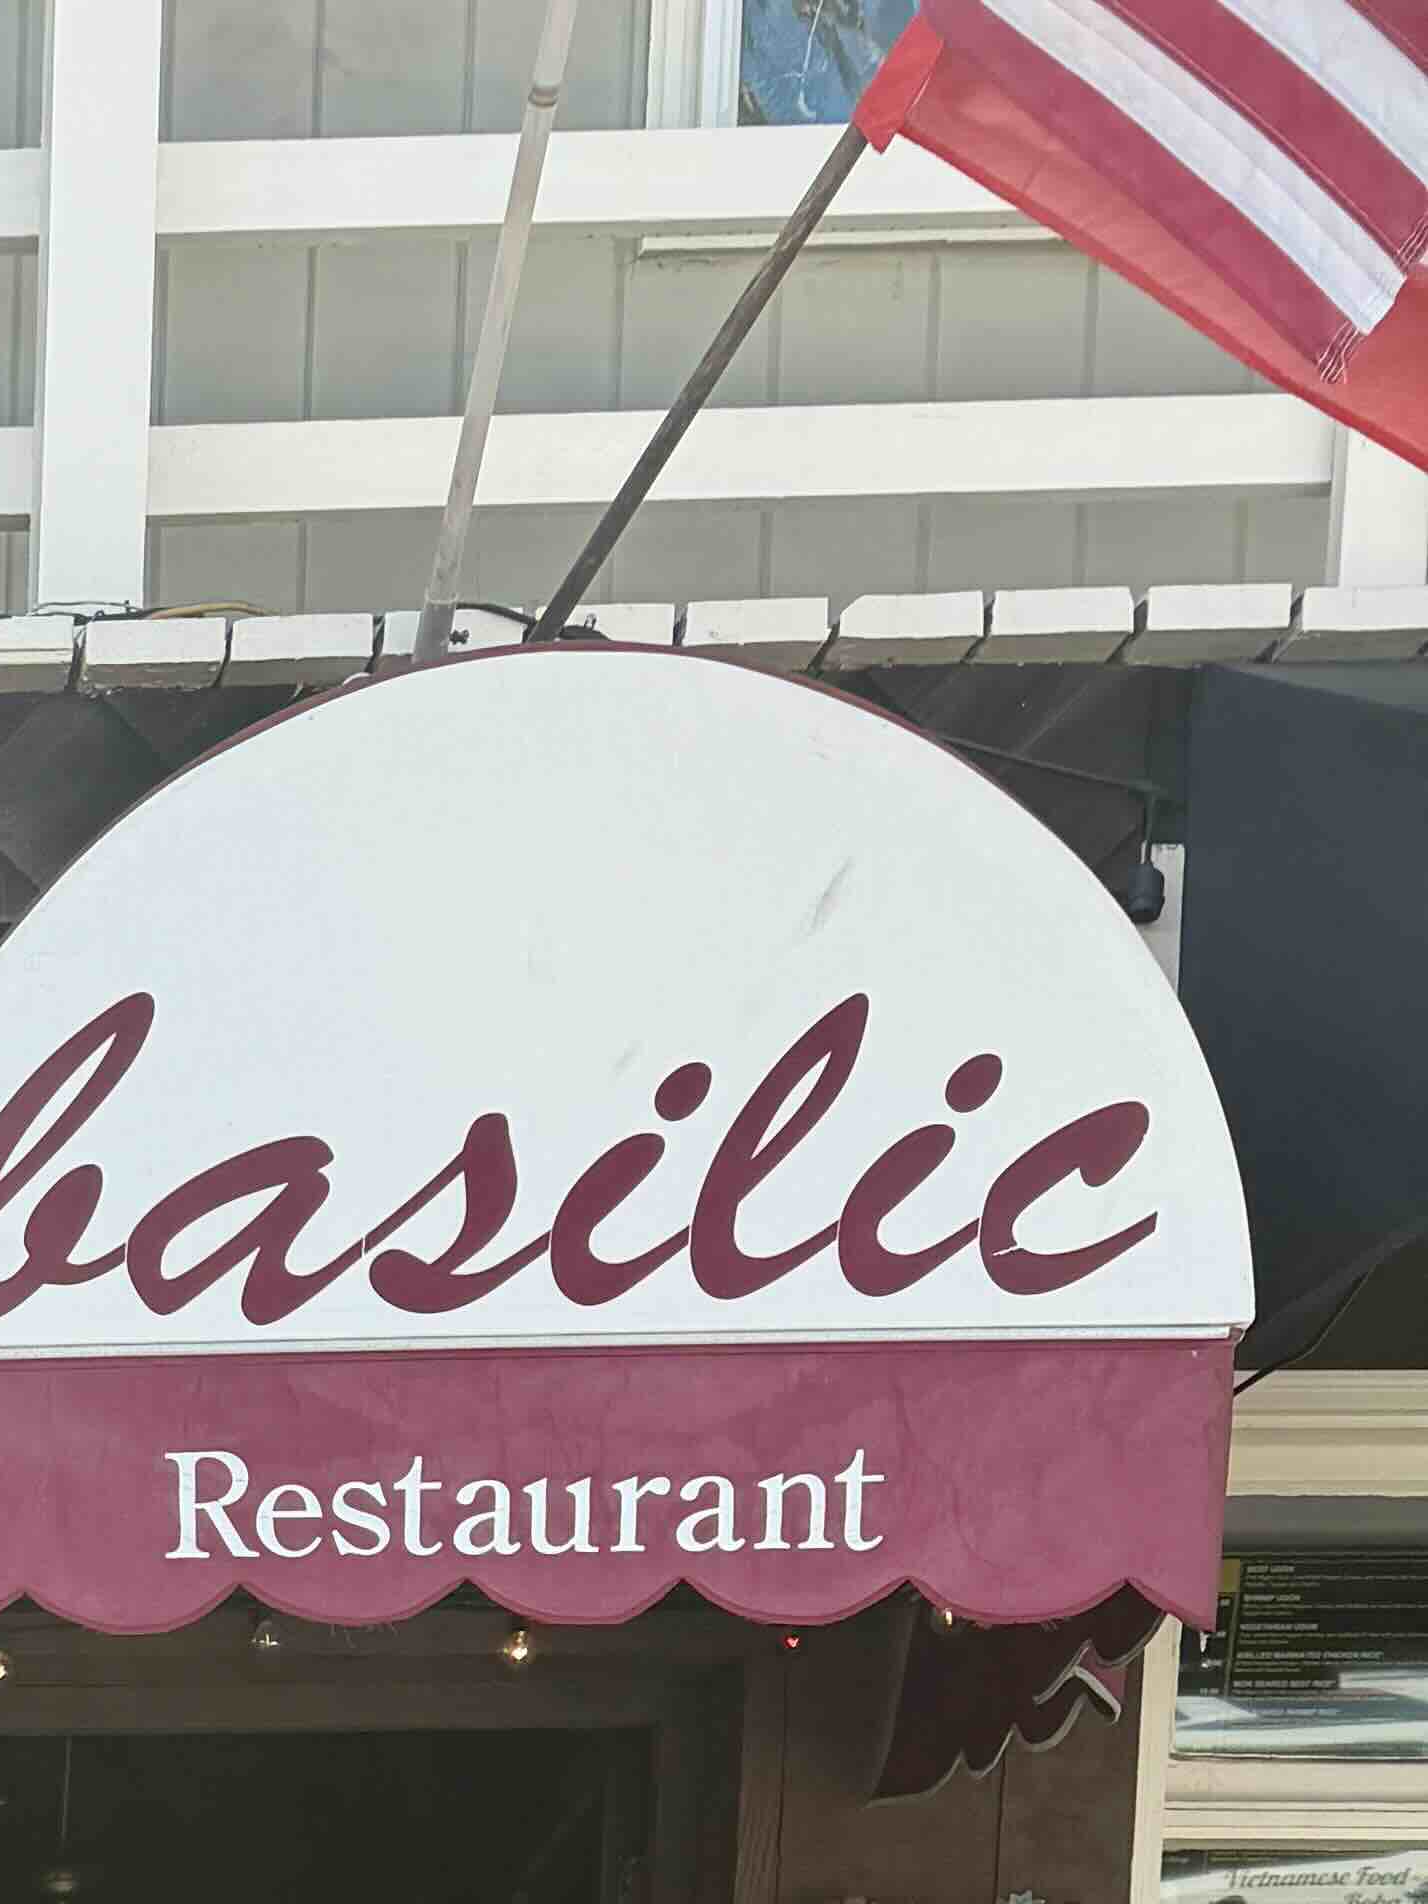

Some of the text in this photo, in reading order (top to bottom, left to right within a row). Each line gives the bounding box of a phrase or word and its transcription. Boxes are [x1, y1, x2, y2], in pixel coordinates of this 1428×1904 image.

[165, 1449, 885, 1559] Restaurant
[1224, 1865, 1412, 1889] Vietnamese Food
